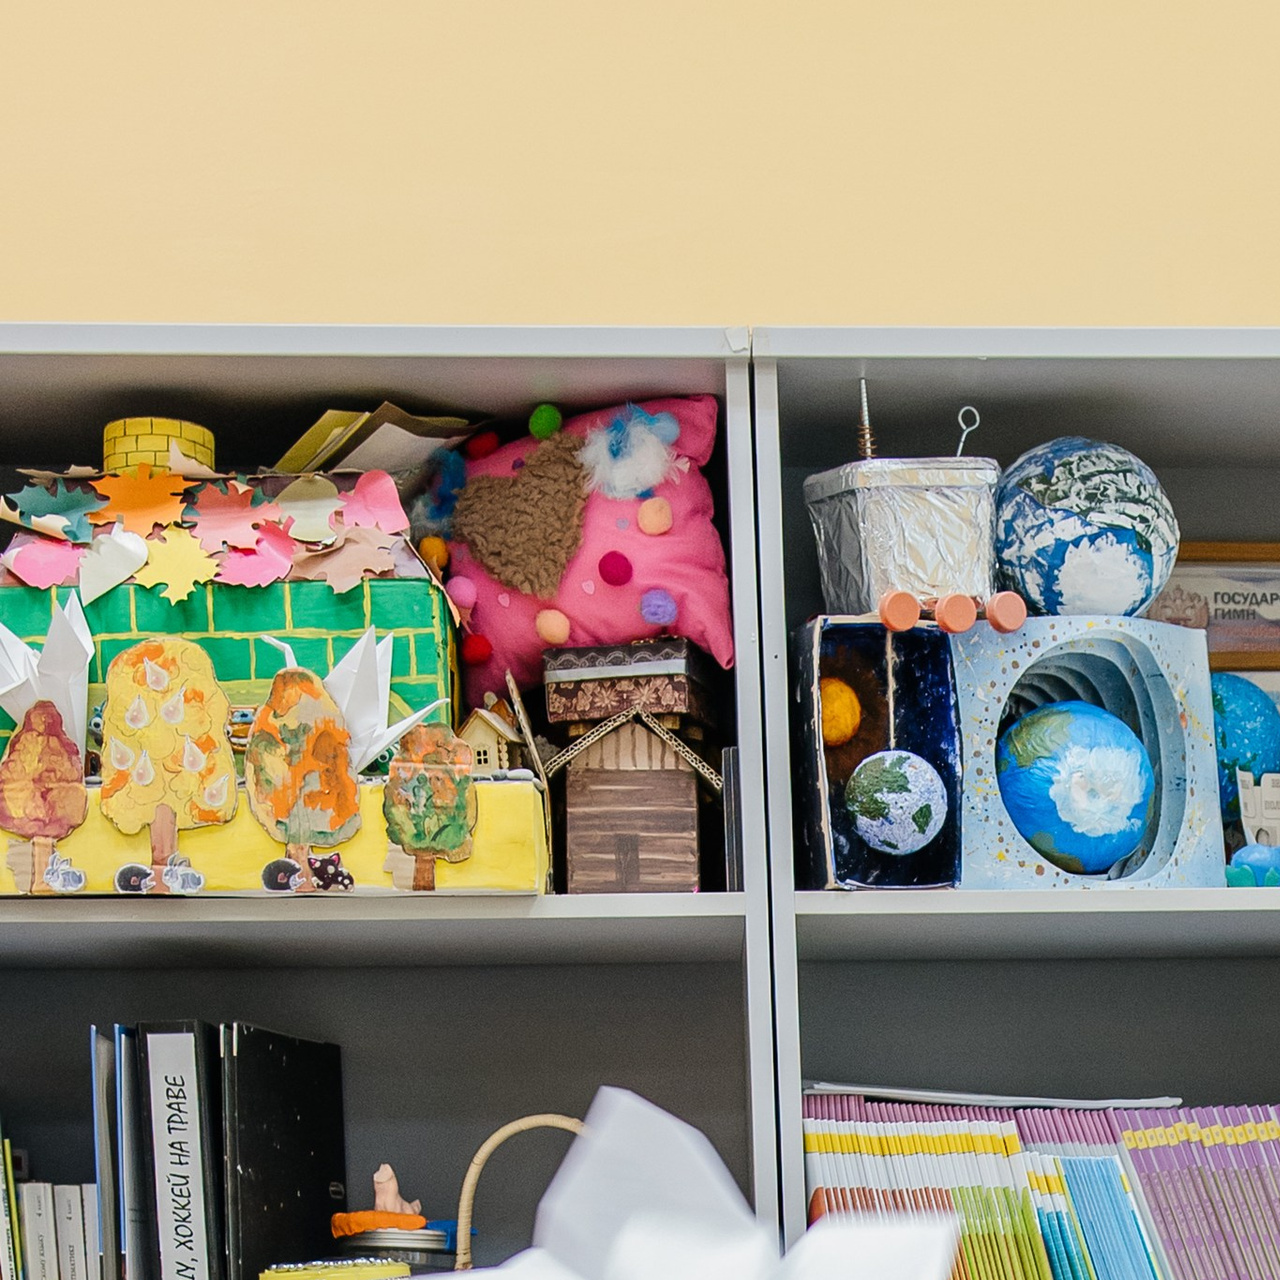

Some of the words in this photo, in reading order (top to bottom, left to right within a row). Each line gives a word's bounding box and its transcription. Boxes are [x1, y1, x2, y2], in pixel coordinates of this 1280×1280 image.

[1214, 608, 1256, 620] ГИМН
[165, 1075, 188, 1134] ТРАВЕ
[168, 1141, 190, 1166] НА
[166, 1173, 194, 1251] ХОККЕЙ
